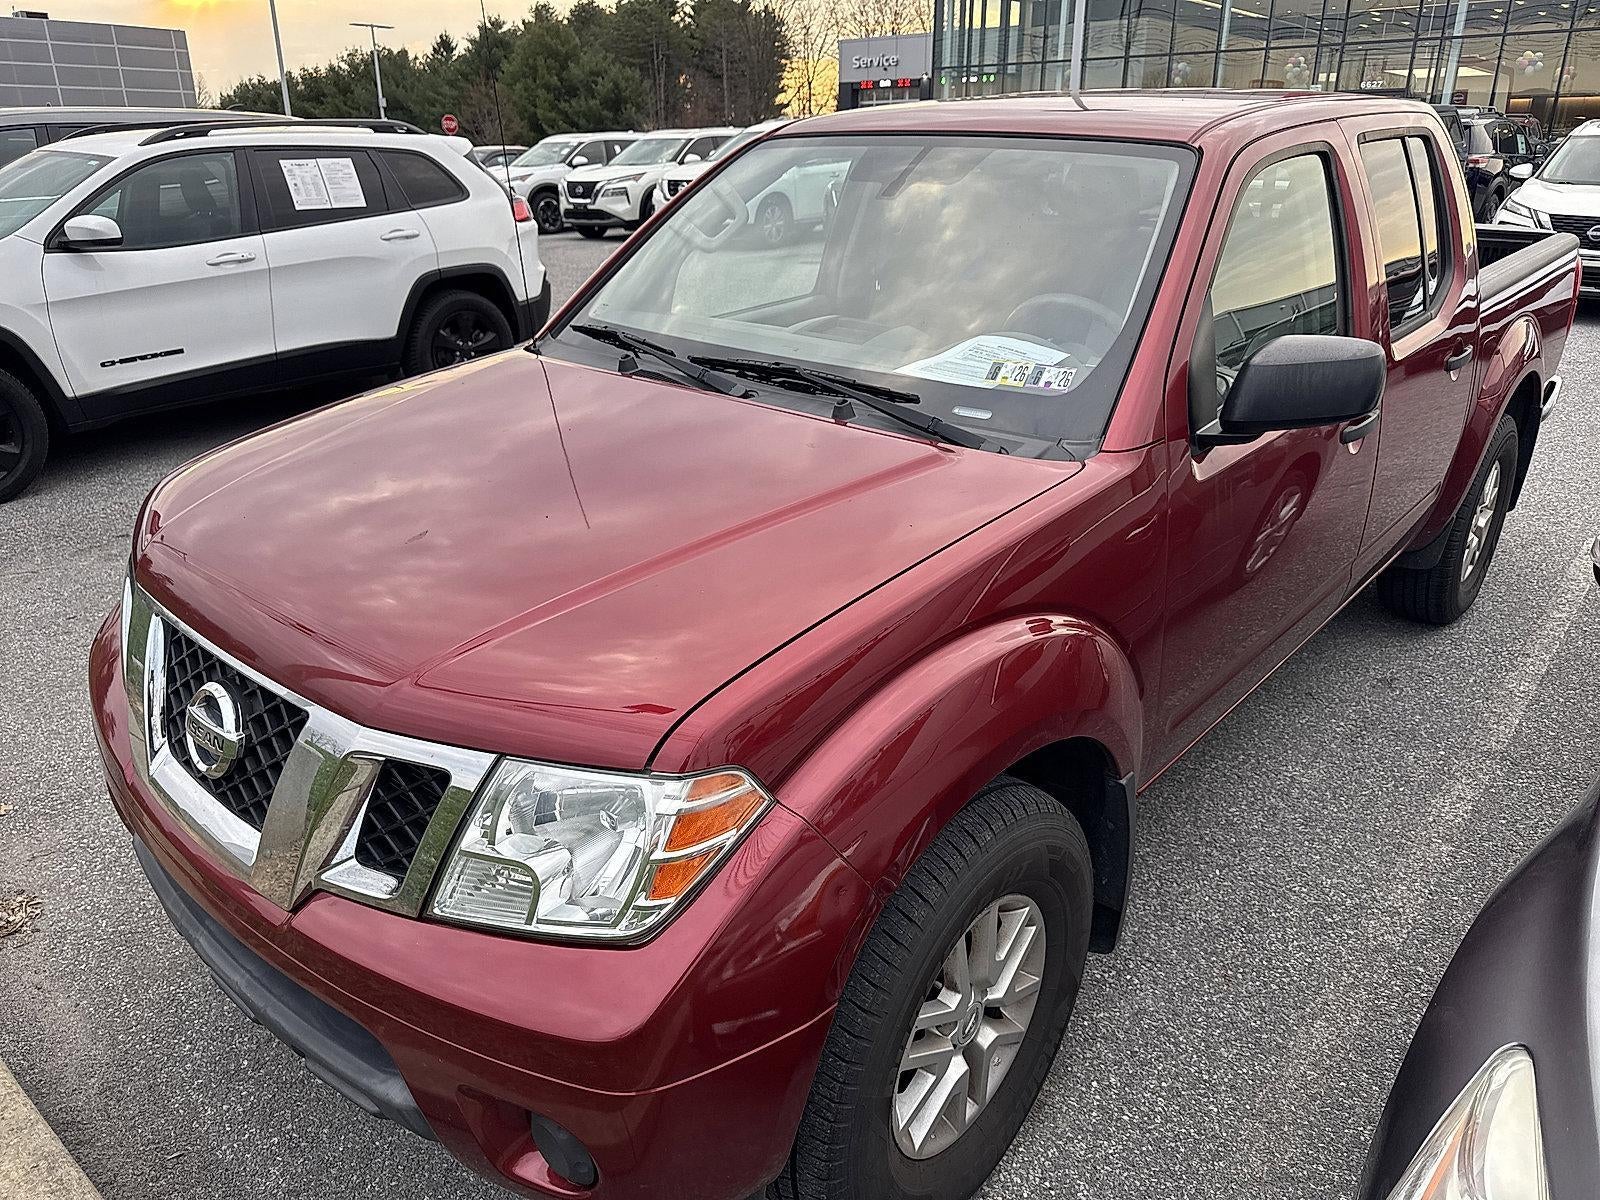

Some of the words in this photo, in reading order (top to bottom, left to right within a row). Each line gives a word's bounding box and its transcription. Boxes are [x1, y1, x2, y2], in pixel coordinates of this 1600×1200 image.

[852, 53, 898, 69] Service
[1360, 80, 1384, 89] 6627
[1013, 365, 1029, 382] 26
[1057, 370, 1073, 388] 26
